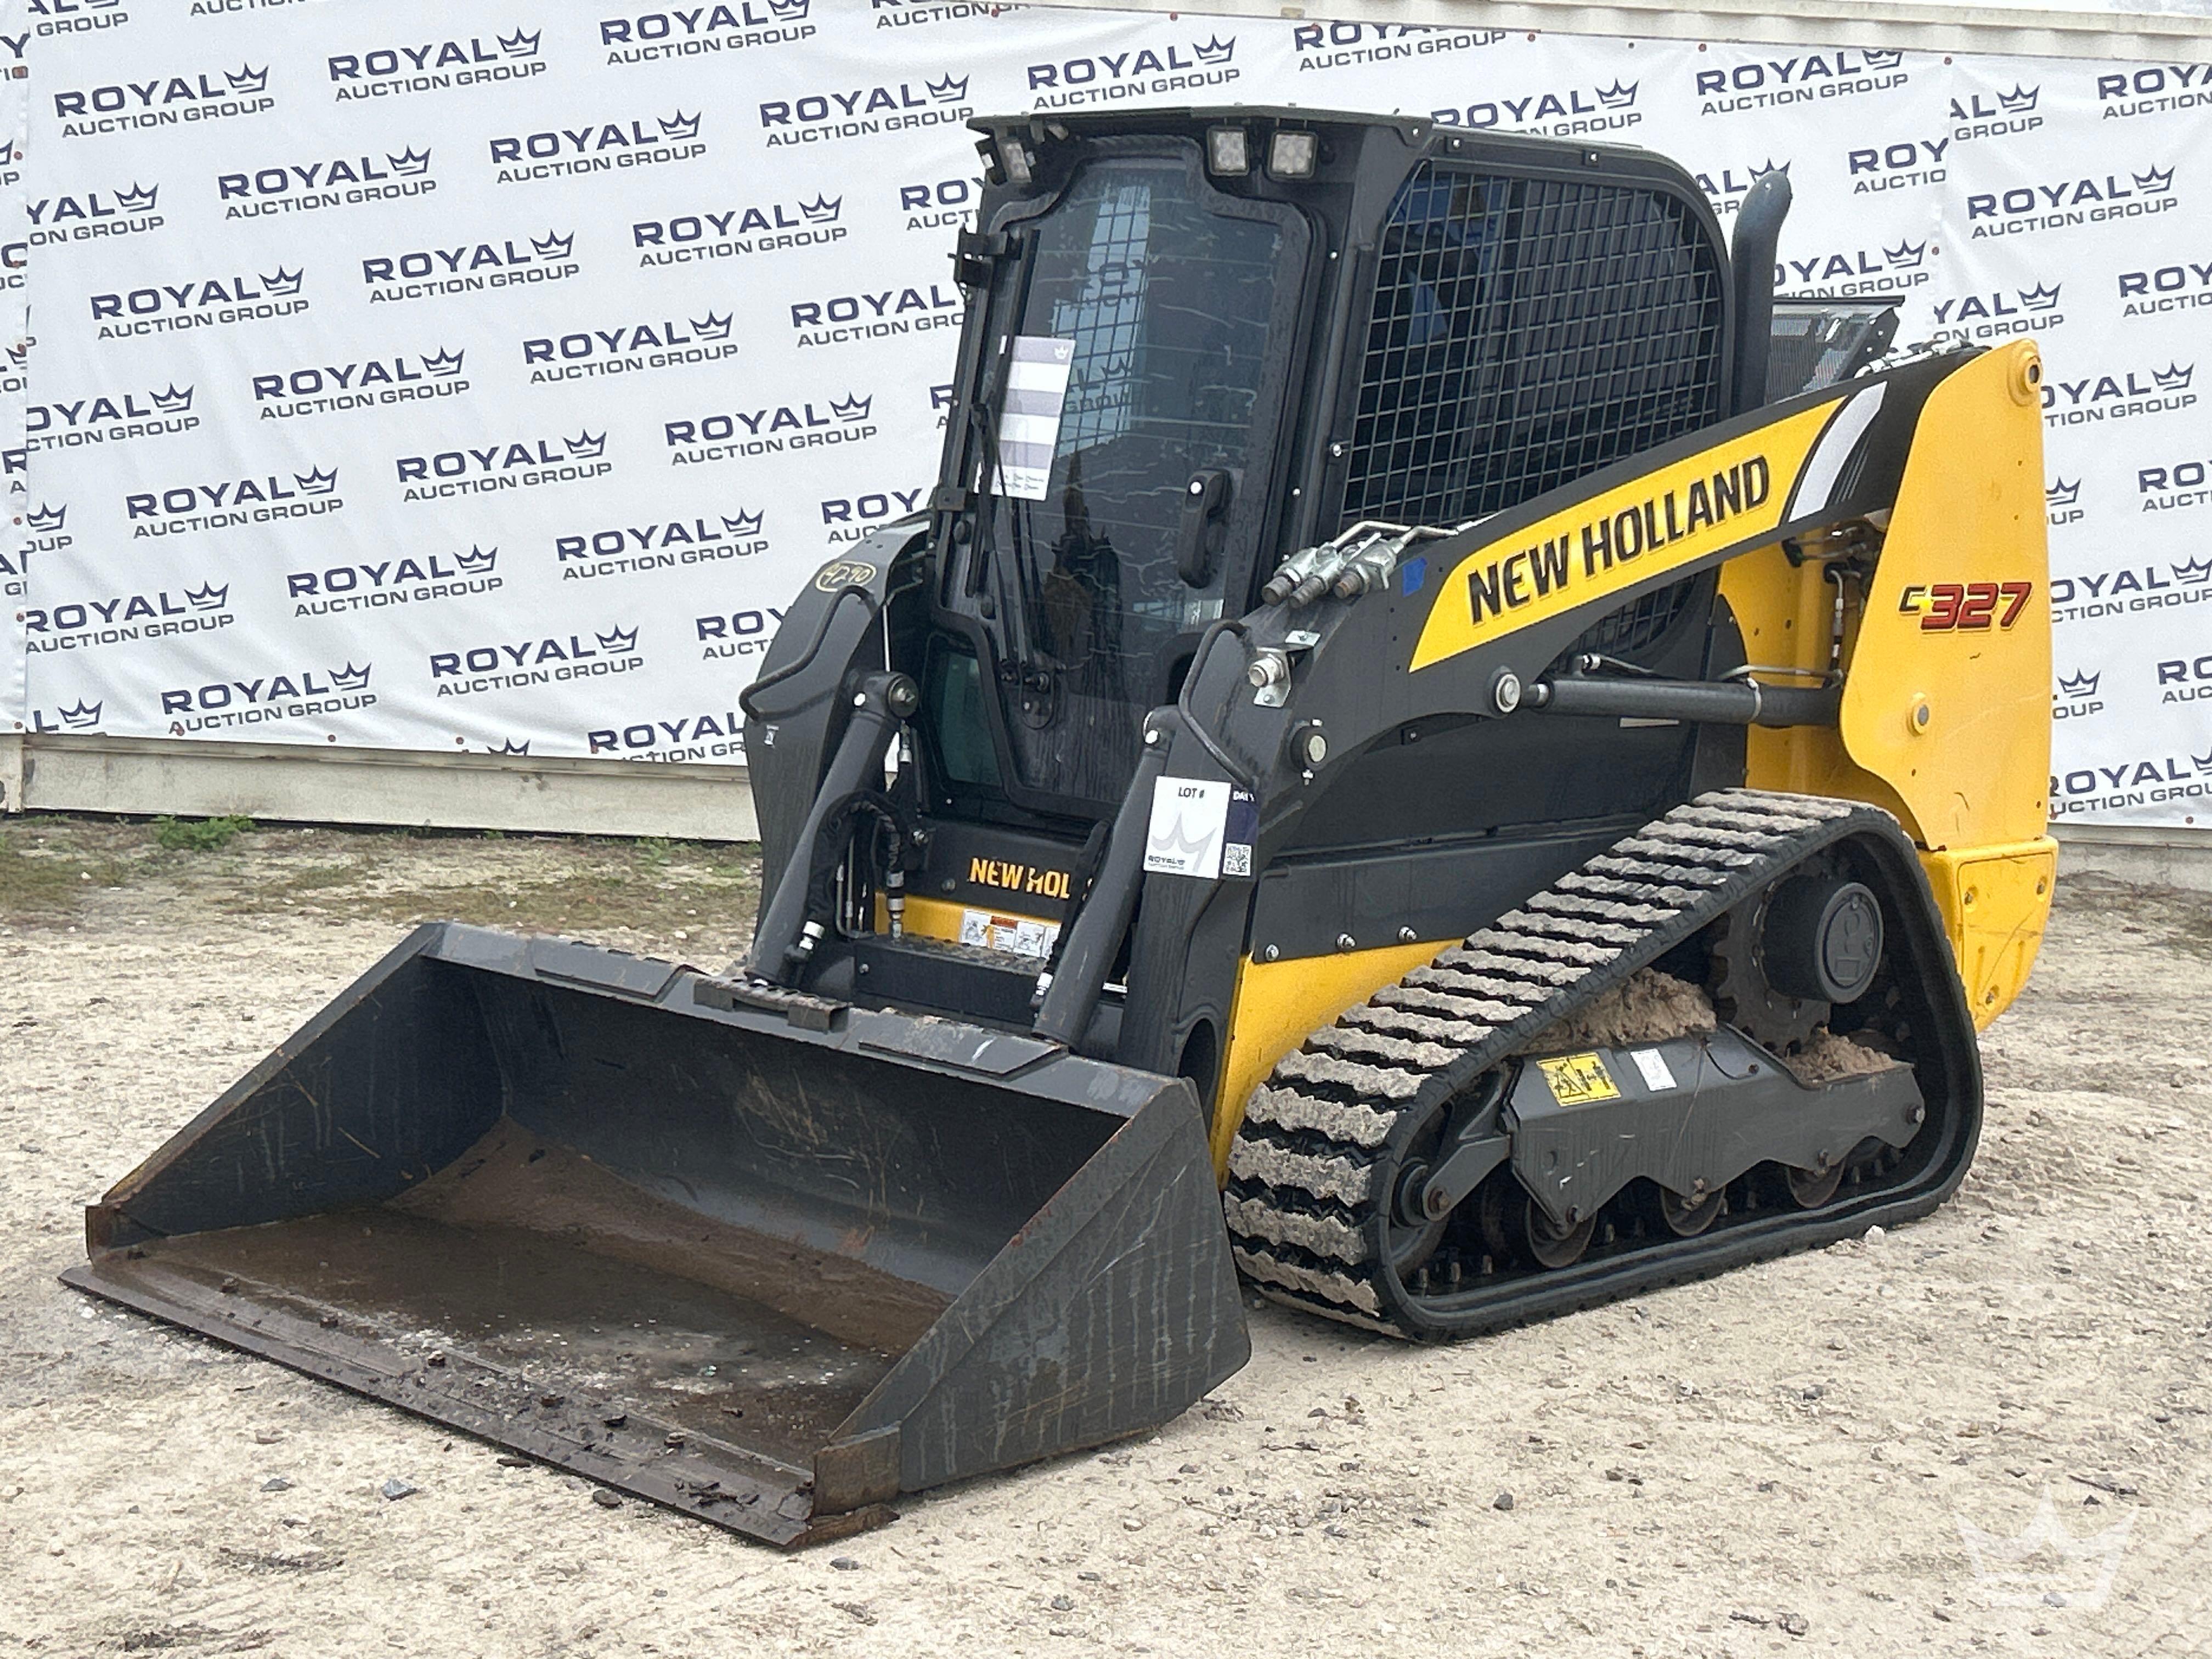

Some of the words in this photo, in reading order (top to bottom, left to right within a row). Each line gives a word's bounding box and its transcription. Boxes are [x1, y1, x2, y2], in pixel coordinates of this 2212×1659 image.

[37, 13, 128, 36] GROUP
[600, 2, 768, 45] ROYAL
[877, 3, 990, 29] AUCTION
[329, 39, 498, 81] ROYAL
[607, 38, 720, 65] AUCTION
[727, 25, 816, 48] GROUP
[1300, 44, 1411, 71] AUCTION
[1418, 31, 1528, 54] GROUP
[336, 75, 450, 101] AUCTION
[456, 63, 546, 85] GROUP
[1028, 46, 1192, 90] ROYAL
[1697, 52, 1861, 95] ROYAL
[54, 75, 225, 117] ROYAL
[760, 84, 926, 127] ROYAL
[1034, 81, 1146, 110] AUCTION
[1152, 69, 1239, 92] GROUP
[1702, 88, 1813, 115] AUCTION
[1820, 74, 1908, 98] GROUP
[2103, 92, 2212, 119] AUCTION
[63, 111, 177, 138] AUCTION
[184, 98, 274, 121] GROUP
[767, 120, 879, 147] AUCTION
[885, 108, 973, 130] GROUP
[1554, 113, 1641, 136] GROUP
[1955, 117, 2042, 140] GROUP
[490, 121, 658, 163] ROYAL
[1848, 138, 1949, 174] ROY
[218, 157, 387, 200] ROYAL
[498, 157, 611, 183] AUCTION
[617, 144, 706, 167] GROUP
[1854, 170, 1945, 194] AUCTIO
[27, 194, 115, 225] YAL
[226, 193, 340, 219] AUCTION
[346, 180, 436, 203] GROUP
[1968, 176, 2131, 219] ROYAL
[74, 216, 163, 240] GROUP
[633, 205, 799, 247] ROYAL
[906, 209, 973, 230] AUCT
[1972, 212, 2084, 239] AUCTION
[2090, 198, 2177, 221] GROUP
[363, 241, 531, 284] ROYAL
[640, 240, 752, 267] AUCTION
[759, 228, 847, 251] GROUP
[91, 278, 261, 320] ROYAL
[370, 276, 483, 303] AUCTION
[490, 264, 579, 287] GROUP
[1842, 273, 1928, 296] GROUP
[2119, 262, 2212, 298] ROY
[98, 313, 213, 340] AUCTION
[219, 300, 308, 323] GROUP
[791, 285, 956, 328] ROYAL
[1934, 293, 2017, 324] YAL
[2123, 293, 2212, 317] AUCTIO
[523, 322, 690, 364] ROYAL
[798, 320, 909, 347] AUCTION
[915, 313, 964, 331] GRO
[1977, 315, 2063, 338] GROUP
[253, 358, 422, 400] ROYAL
[531, 358, 643, 384] AUCTION
[650, 345, 737, 367] GROUP
[26, 395, 151, 432] OYAL
[261, 393, 374, 419] AUCTION
[380, 381, 469, 403] GROUP
[2045, 408, 2103, 427] TION
[2111, 394, 2197, 417] GROUP
[26, 430, 103, 452] CTION
[110, 417, 200, 439] GROUP
[665, 404, 830, 445] ROYAL
[397, 441, 564, 482] ROYAL
[673, 439, 783, 465] AUCTION
[789, 426, 877, 449] GROUP
[126, 477, 295, 519] ROYAL
[404, 476, 516, 502] AUCTION
[523, 463, 611, 486] GROUP
[2142, 492, 2209, 512] AUCT
[134, 512, 248, 539] AUCTION
[254, 499, 343, 522] GROUP
[821, 488, 922, 524] ROY
[556, 519, 721, 561] ROYAL
[1468, 534, 1570, 625] NEW
[1581, 455, 1769, 577] HOLLAND
[287, 556, 455, 597] ROYAL
[563, 554, 675, 580] AUCTION
[681, 541, 768, 563] GROUP
[295, 591, 408, 617] AUCTION
[414, 578, 503, 600] GROUP
[2051, 567, 2170, 603] OYAL
[26, 592, 185, 635] ROYAL
[2051, 601, 2123, 623] CTION
[26, 627, 138, 654] AUCTION
[145, 614, 234, 637] GROUP
[703, 639, 768, 659] AUCT
[430, 636, 596, 678] ROYAL
[161, 673, 329, 715] ROYAL
[437, 670, 549, 697] AUCTION
[555, 658, 643, 680] GROUP
[169, 707, 282, 734] AUCTION
[288, 695, 376, 716] GROUP
[2052, 702, 2103, 719] OUP
[1178, 787, 1197, 798] LOT
[2051, 792, 2144, 814] UCTION
[969, 857, 1024, 890] NEW
